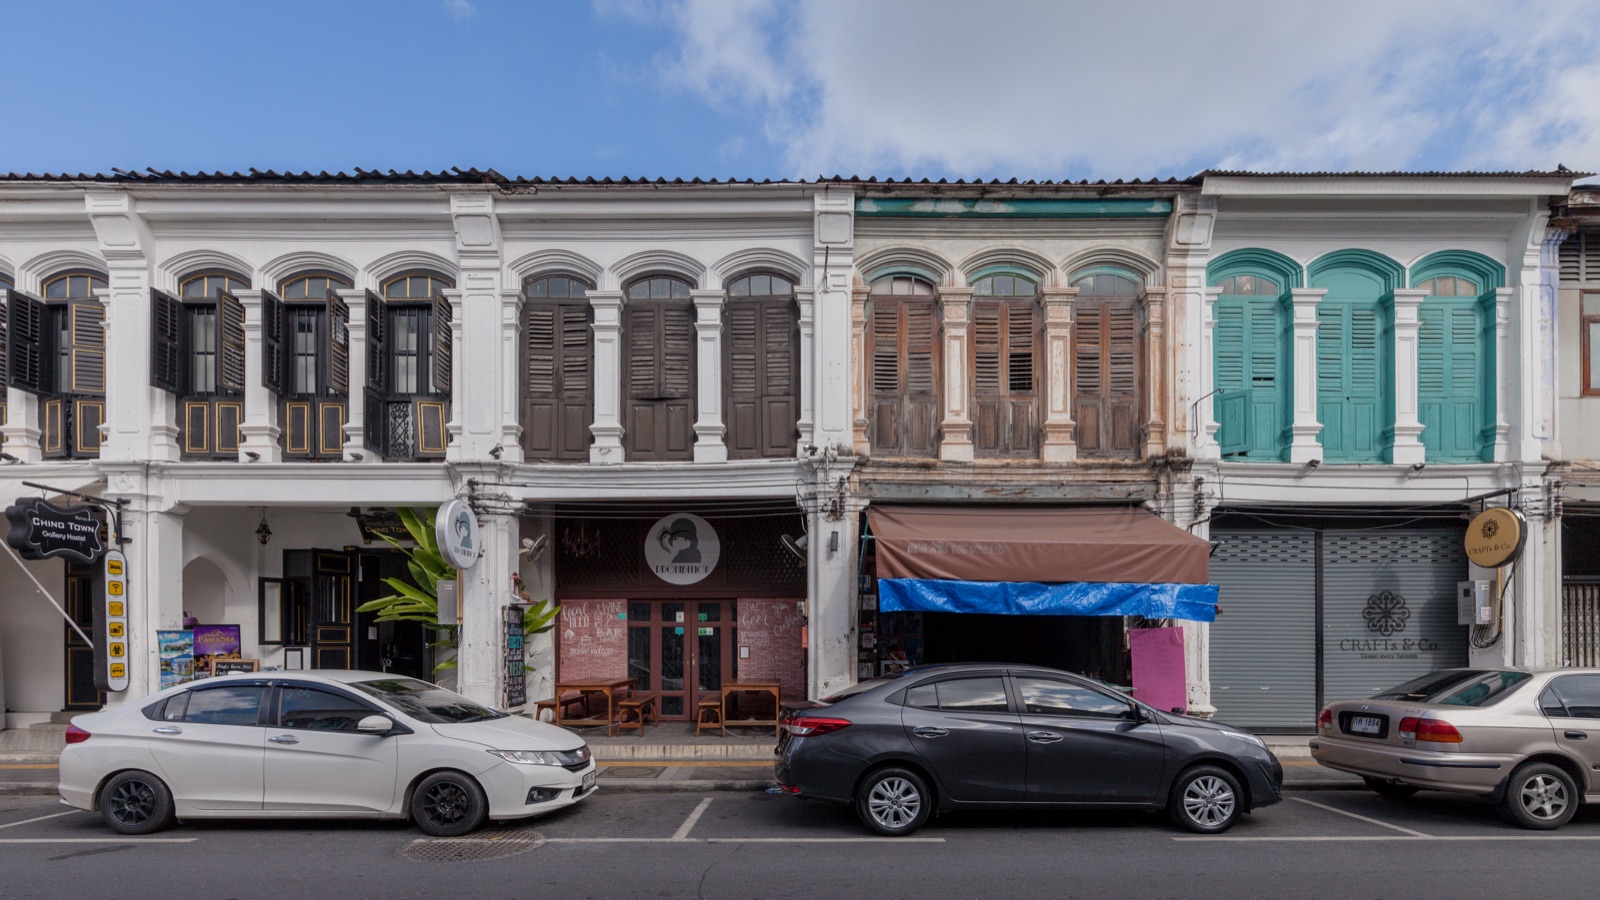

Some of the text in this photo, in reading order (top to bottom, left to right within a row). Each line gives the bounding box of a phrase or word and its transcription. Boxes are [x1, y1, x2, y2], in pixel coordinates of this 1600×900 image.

[32, 517, 65, 529] CHINO
[67, 521, 95, 533] TOWN
[42, 530, 86, 542] Gallery Hostel
[602, 601, 624, 613] WINE
[596, 628, 622, 637] BAR
[1340, 638, 1398, 651] CRAFTs
[1402, 638, 1415, 651] &
